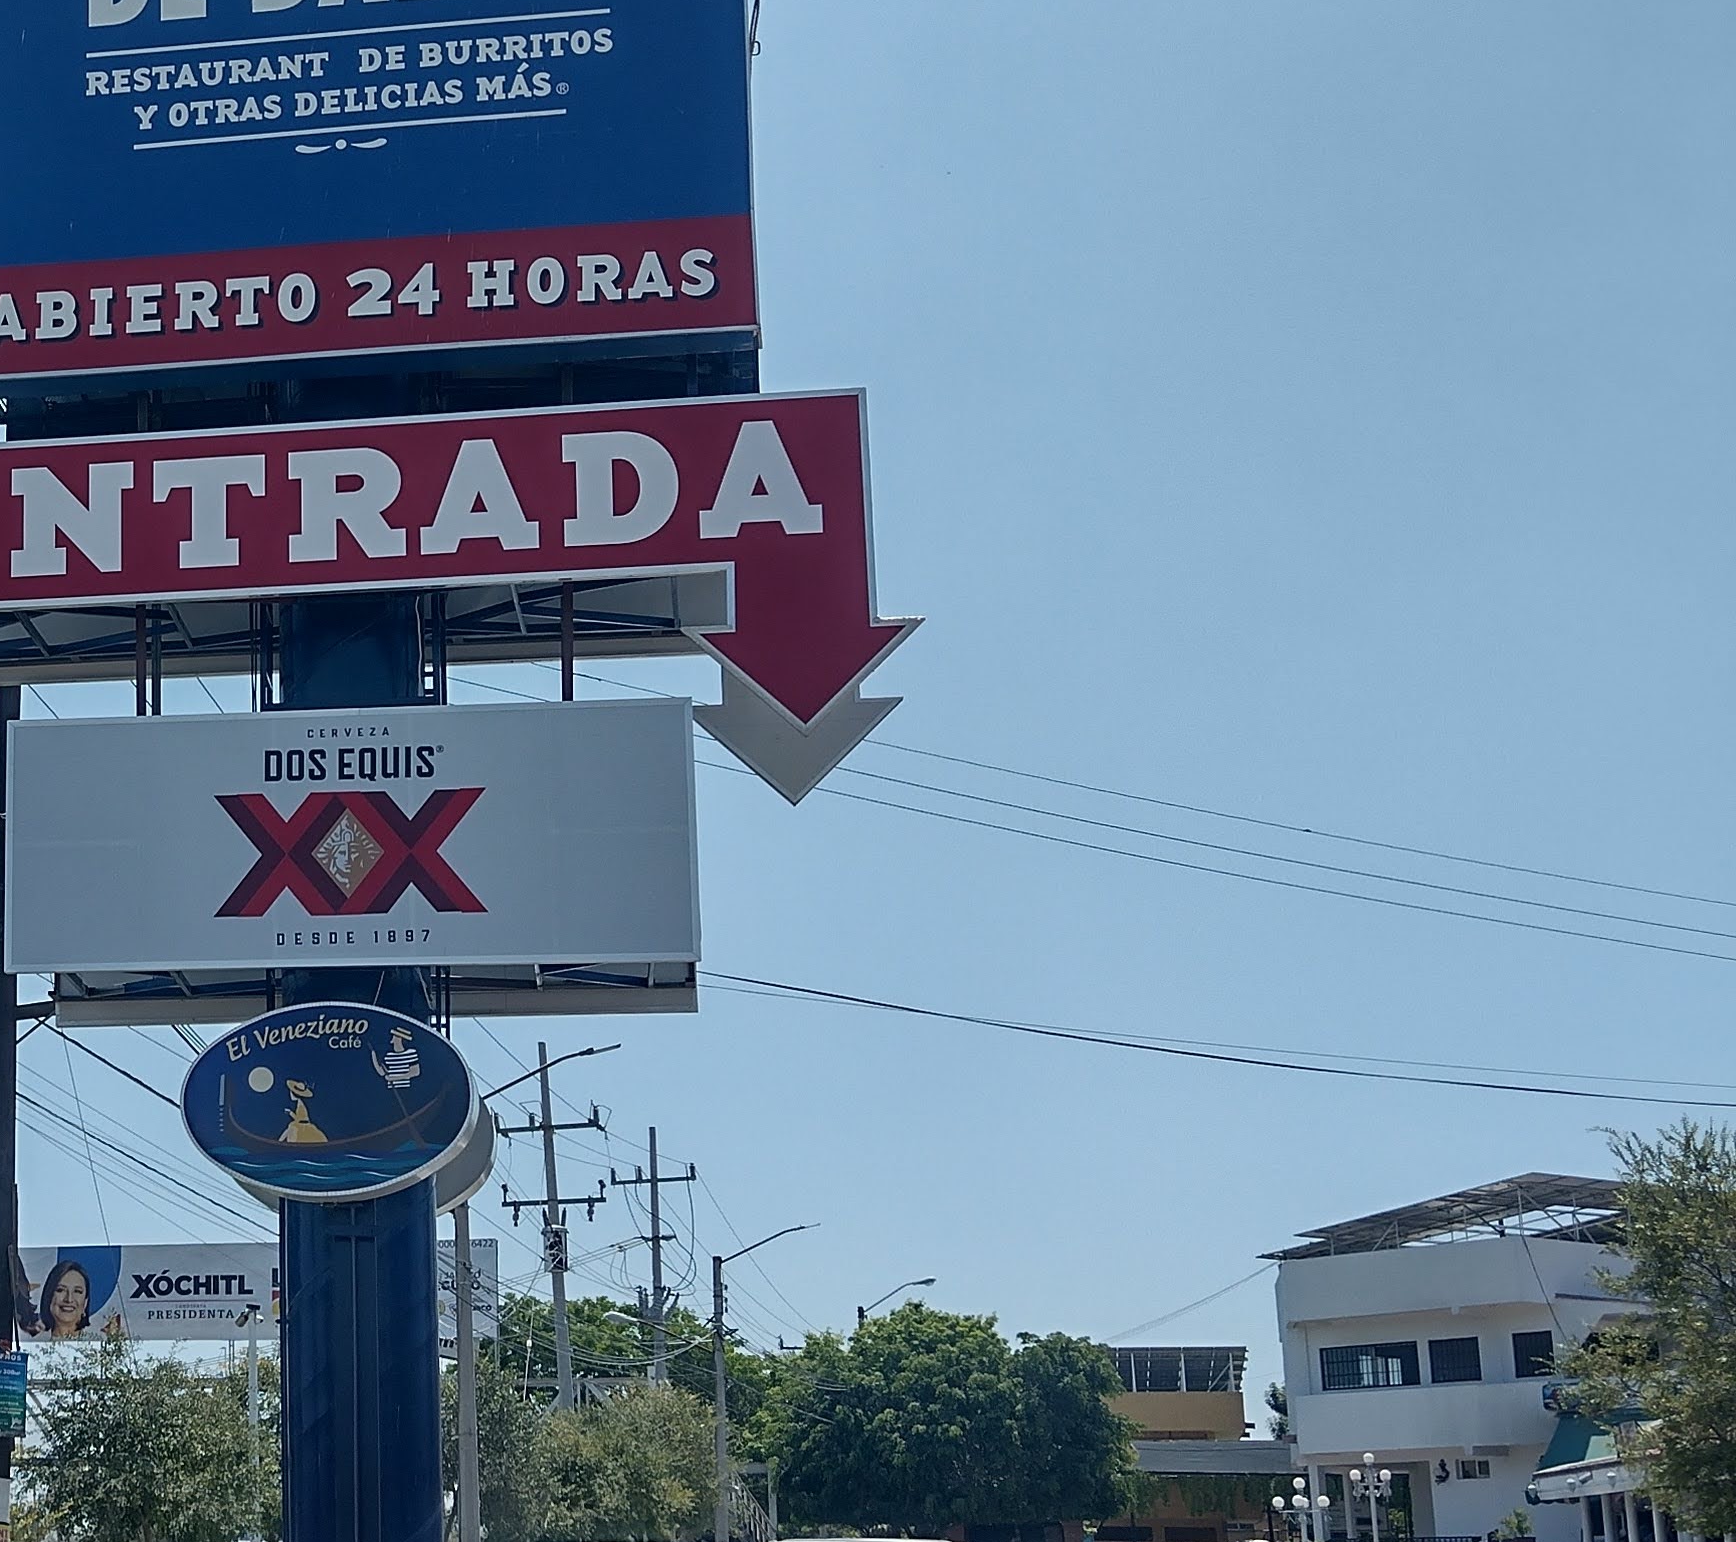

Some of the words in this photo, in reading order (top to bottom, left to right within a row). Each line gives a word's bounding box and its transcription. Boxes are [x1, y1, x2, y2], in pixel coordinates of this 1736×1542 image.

[85, 51, 330, 97] RESTAURANT
[358, 46, 406, 74] DE
[418, 28, 614, 69] BURRITOS
[134, 105, 161, 130] Y
[169, 97, 283, 130] OTRAS
[294, 80, 463, 118] DELICIAS
[476, 63, 552, 102] MÁS
[346, 263, 440, 318] 24
[466, 249, 716, 309] HORAS
[307, 726, 390, 739] CERVEZA
[264, 748, 327, 782] DOS
[338, 745, 435, 782] EQUIS
[214, 787, 489, 918] XX
[276, 931, 355, 946] DESDE
[374, 929, 430, 944] 1897
[226, 1037, 251, 1062] El
[253, 1014, 369, 1050] Veneziano
[328, 1036, 362, 1050] Café
[129, 1270, 254, 1299] XÓCHITL
[148, 1309, 235, 1320] PRESIDENTA
